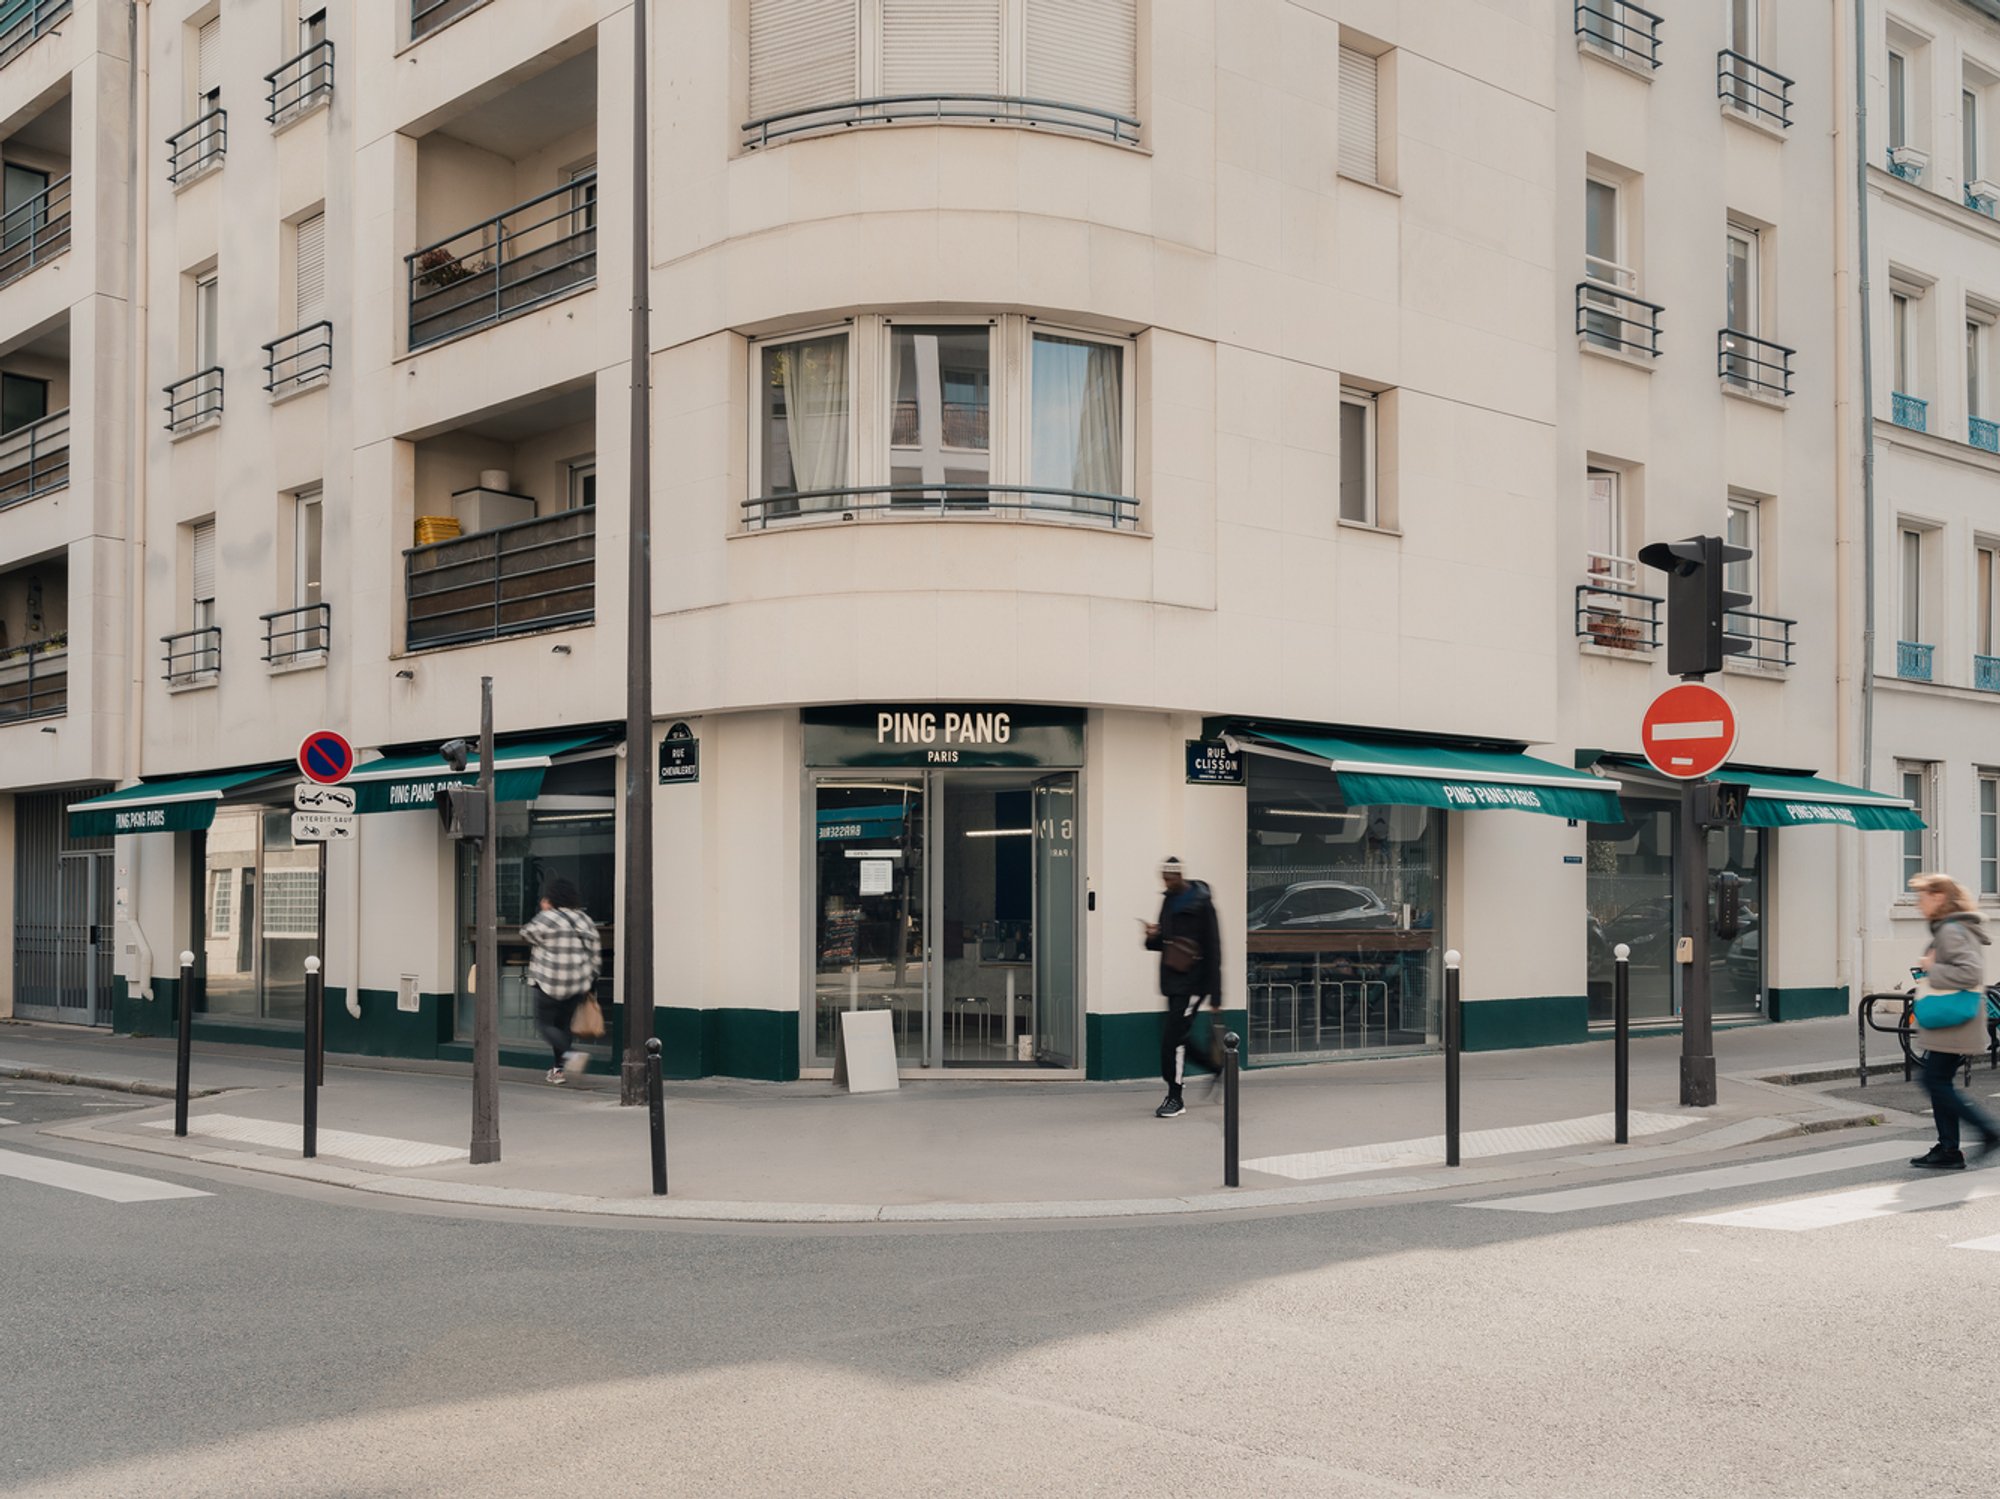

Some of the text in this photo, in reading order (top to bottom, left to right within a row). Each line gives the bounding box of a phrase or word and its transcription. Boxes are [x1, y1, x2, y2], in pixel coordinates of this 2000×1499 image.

[877, 712, 1011, 744] PING PANG
[671, 747, 686, 759] RUE
[927, 751, 959, 763] PARIS
[1206, 747, 1227, 759] RUE
[1194, 758, 1238, 771] CLISSON
[389, 784, 410, 805] PING
[410, 782, 435, 803] PANG
[1442, 785, 1541, 808] PING PANG PARIS
[296, 815, 331, 823] INTERDIT
